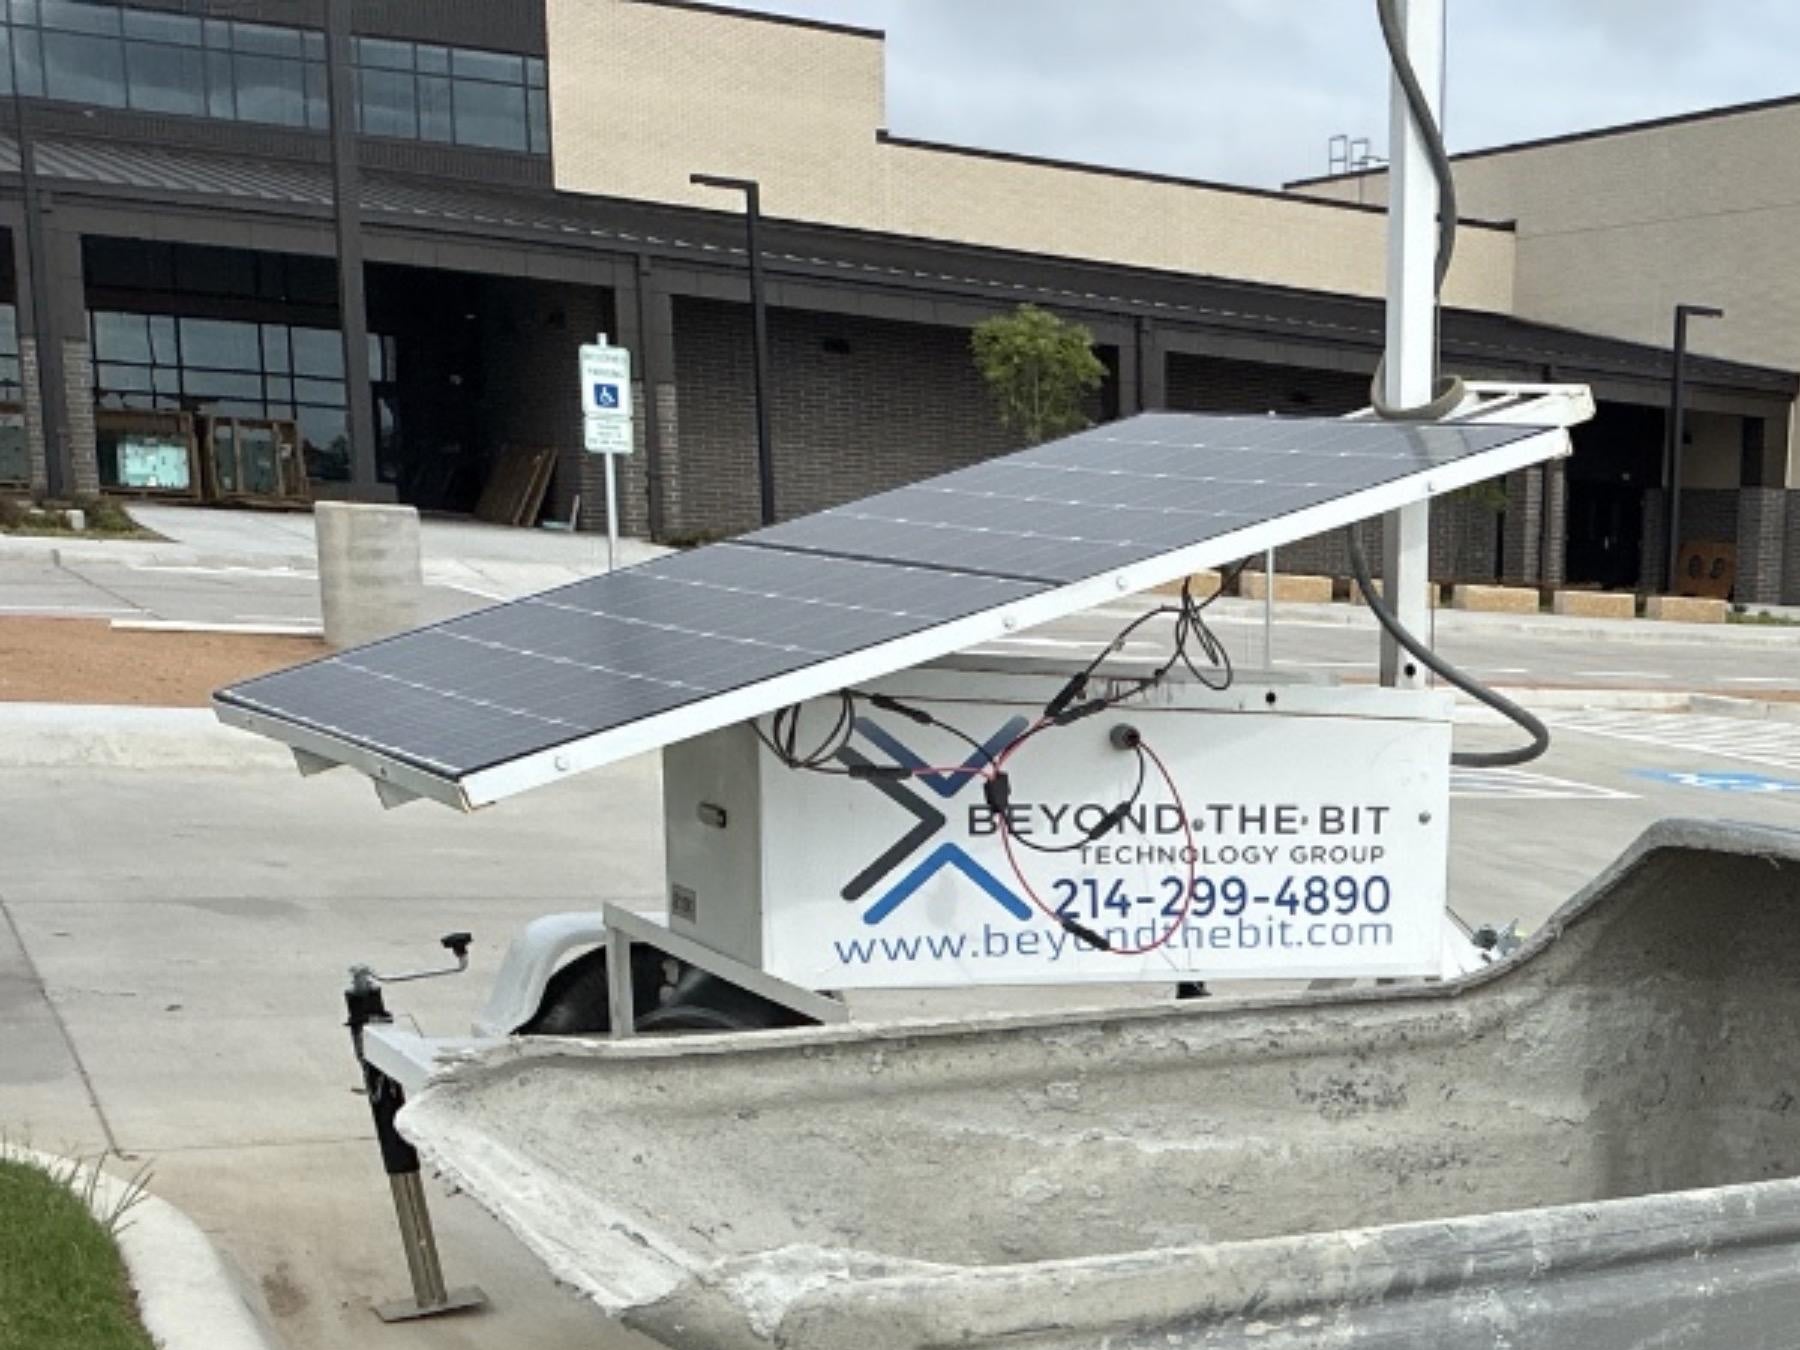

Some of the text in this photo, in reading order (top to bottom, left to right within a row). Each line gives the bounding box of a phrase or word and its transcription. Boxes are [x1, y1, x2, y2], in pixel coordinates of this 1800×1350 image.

[1079, 845, 1386, 866] TECHNOLOGY GROUP
[1051, 875, 1391, 919] 214-299-4890
